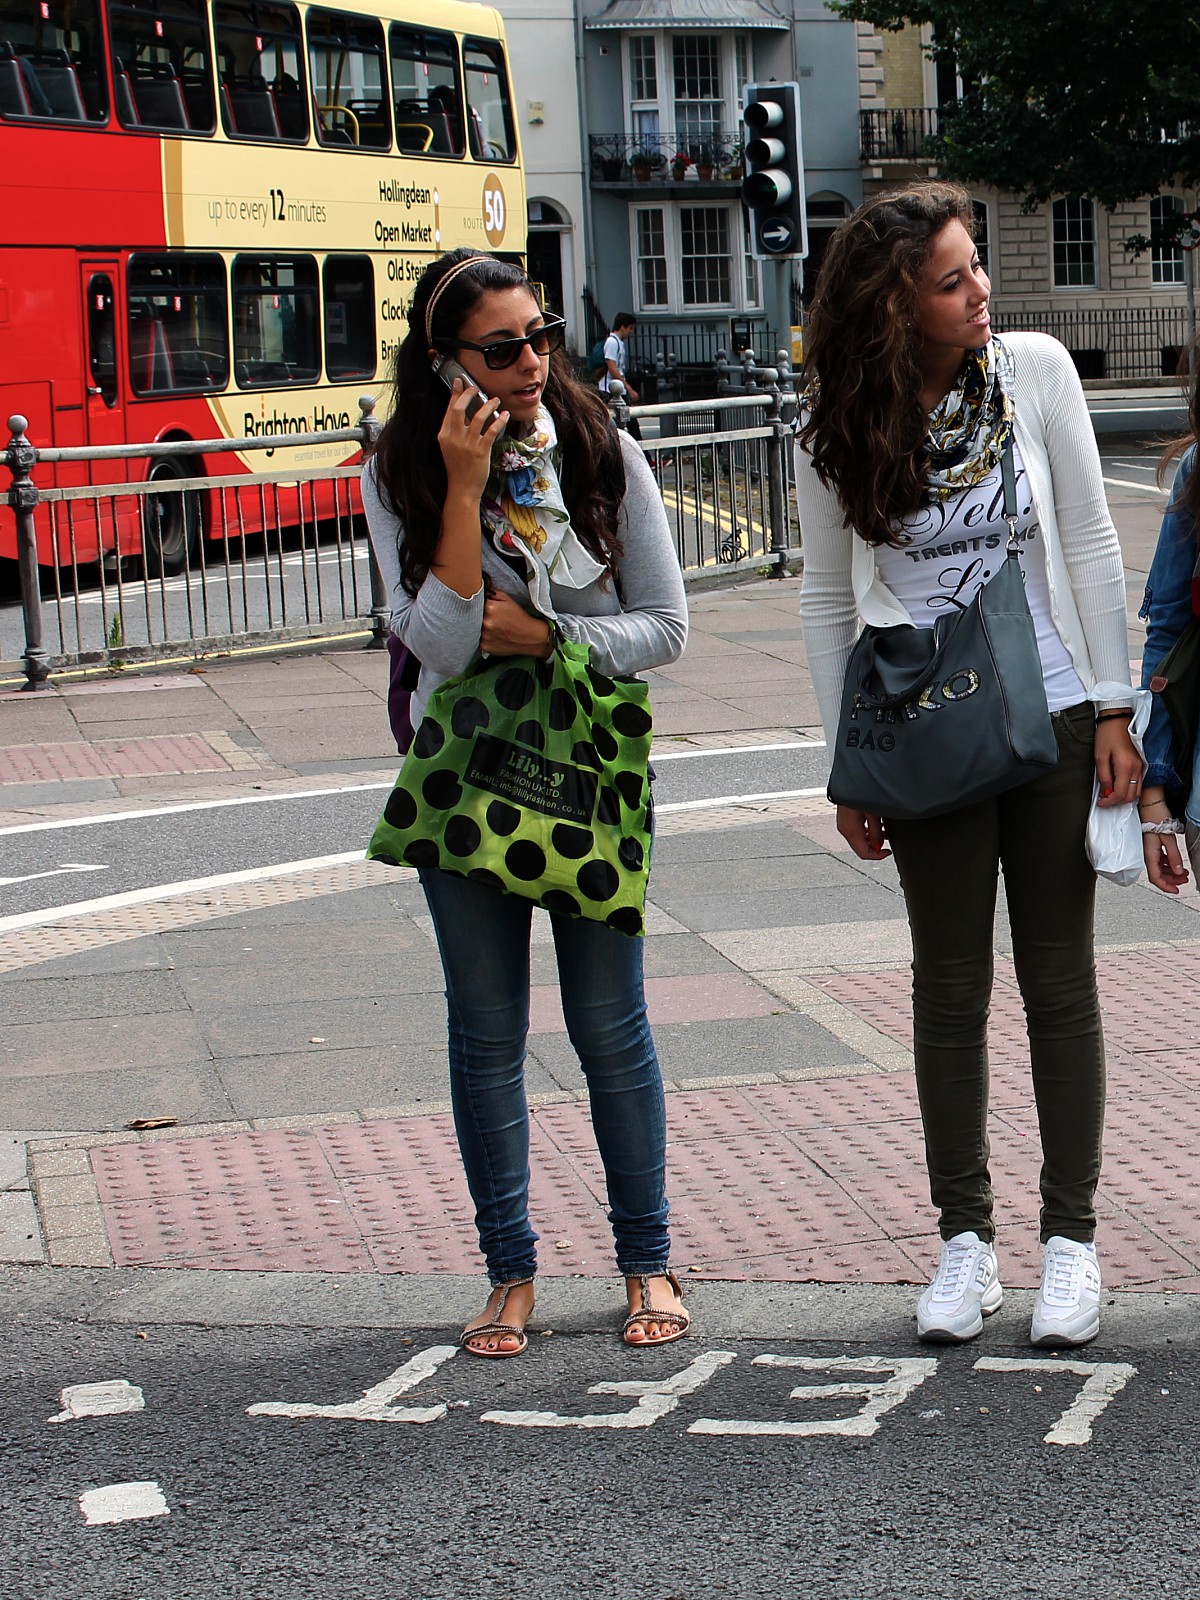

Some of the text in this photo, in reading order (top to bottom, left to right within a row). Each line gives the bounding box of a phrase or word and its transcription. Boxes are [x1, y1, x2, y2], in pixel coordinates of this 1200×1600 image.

[207, 188, 327, 228] up to every 12 minutes
[379, 180, 431, 209] Hollingdean
[463, 190, 505, 232] ROUTE 50
[374, 219, 432, 249] Open Market
[387, 258, 431, 284] Old Stein
[381, 298, 406, 327] Clock
[905, 534, 1001, 562] TREATS
[846, 727, 896, 752] BAG
[500, 769, 532, 789] FASHION
[531, 783, 546, 794] UK
[245, 1345, 1138, 1446] LEFT
